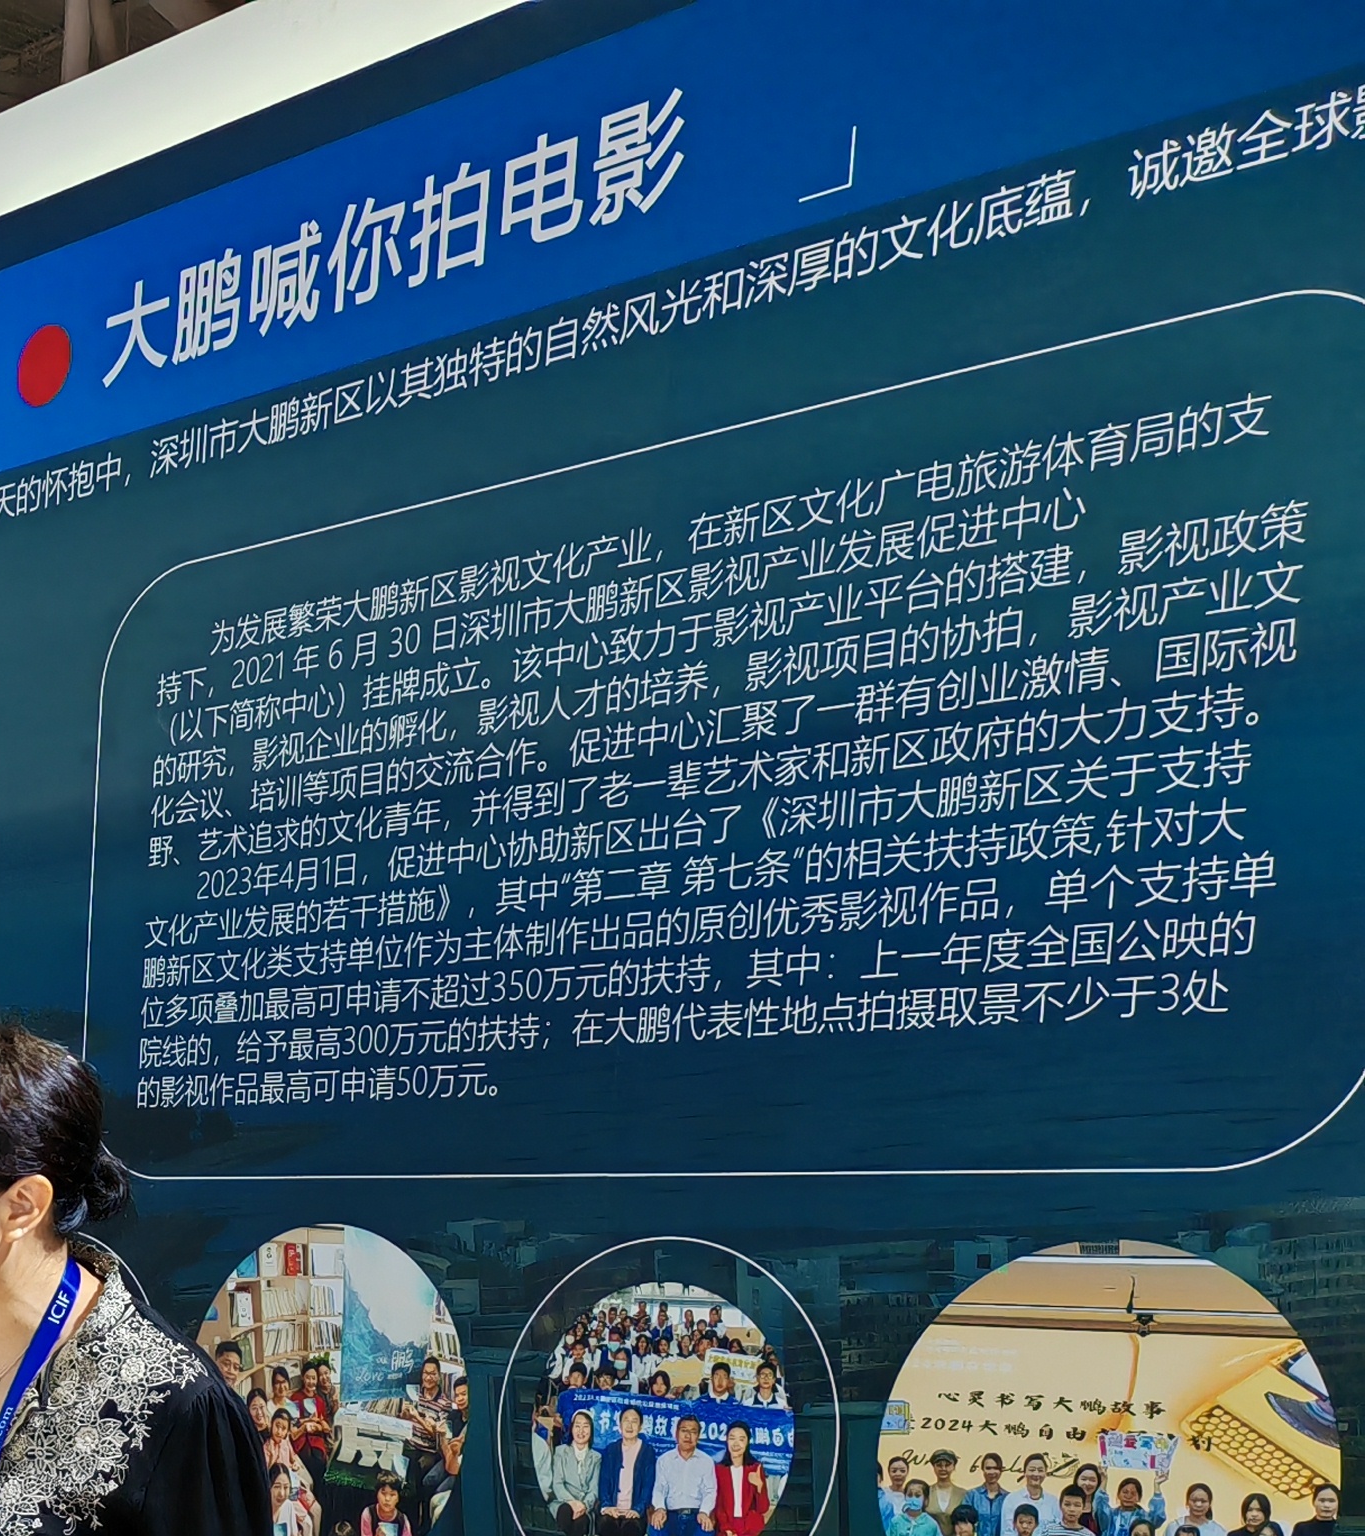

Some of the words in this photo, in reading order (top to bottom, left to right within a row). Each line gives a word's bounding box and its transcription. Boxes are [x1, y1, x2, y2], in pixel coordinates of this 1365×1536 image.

[102, 88, 684, 388] 大鹏喊你拍电影
[210, 393, 1272, 656] 为发展繁荣大鹏新区影视文化产业，在新区文化广电旅游体育局的支
[150, 619, 1297, 828] 化会议、培训等项目的交流合作。促进中心汇聚了一群有创业激情、国际视
[152, 561, 1303, 788] 的研究，影视企业的孵化，影视人才的培养，影视项目的协拍，影视产业文
[148, 686, 1259, 868] 野、艺术追求的文化青年，并得到了老一辈艺术家和新区政府的大力支持。
[142, 851, 1276, 988] 鹏新区文化类支持单位作为主体制作出品的原创优秀影视作品，单个支持单
[136, 1062, 499, 1109] 的影视作品最高可申请50万元。
[48, 1290, 70, 1325] ICIF
